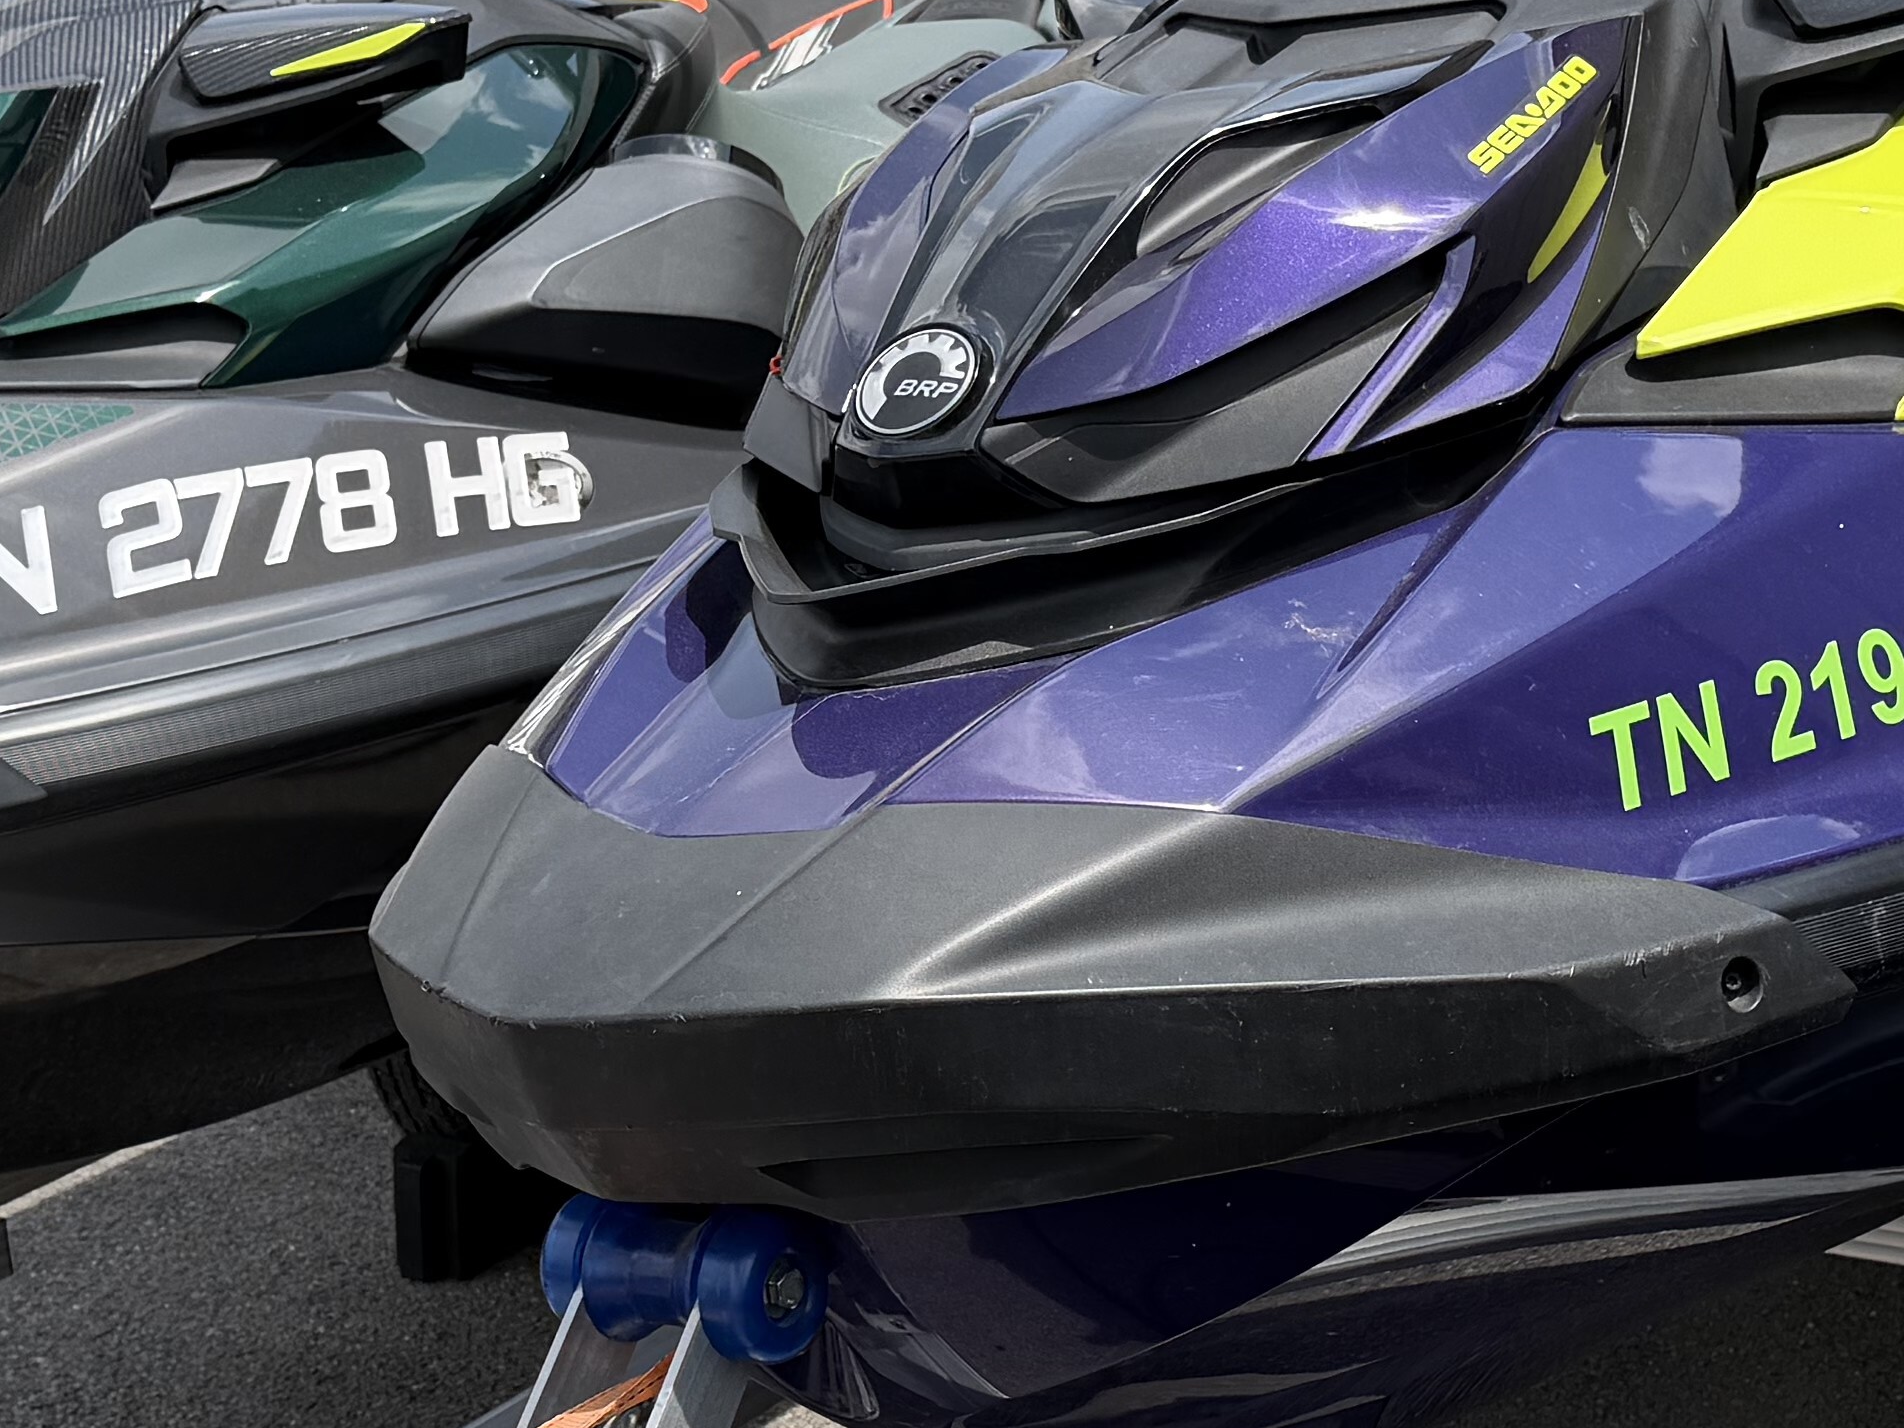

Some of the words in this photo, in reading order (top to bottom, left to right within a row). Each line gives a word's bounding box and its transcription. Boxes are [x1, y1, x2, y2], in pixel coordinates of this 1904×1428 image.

[893, 378, 959, 398] BRP
[99, 448, 397, 600] 2778
[422, 431, 581, 538] HG
[1588, 678, 1730, 812] TN
